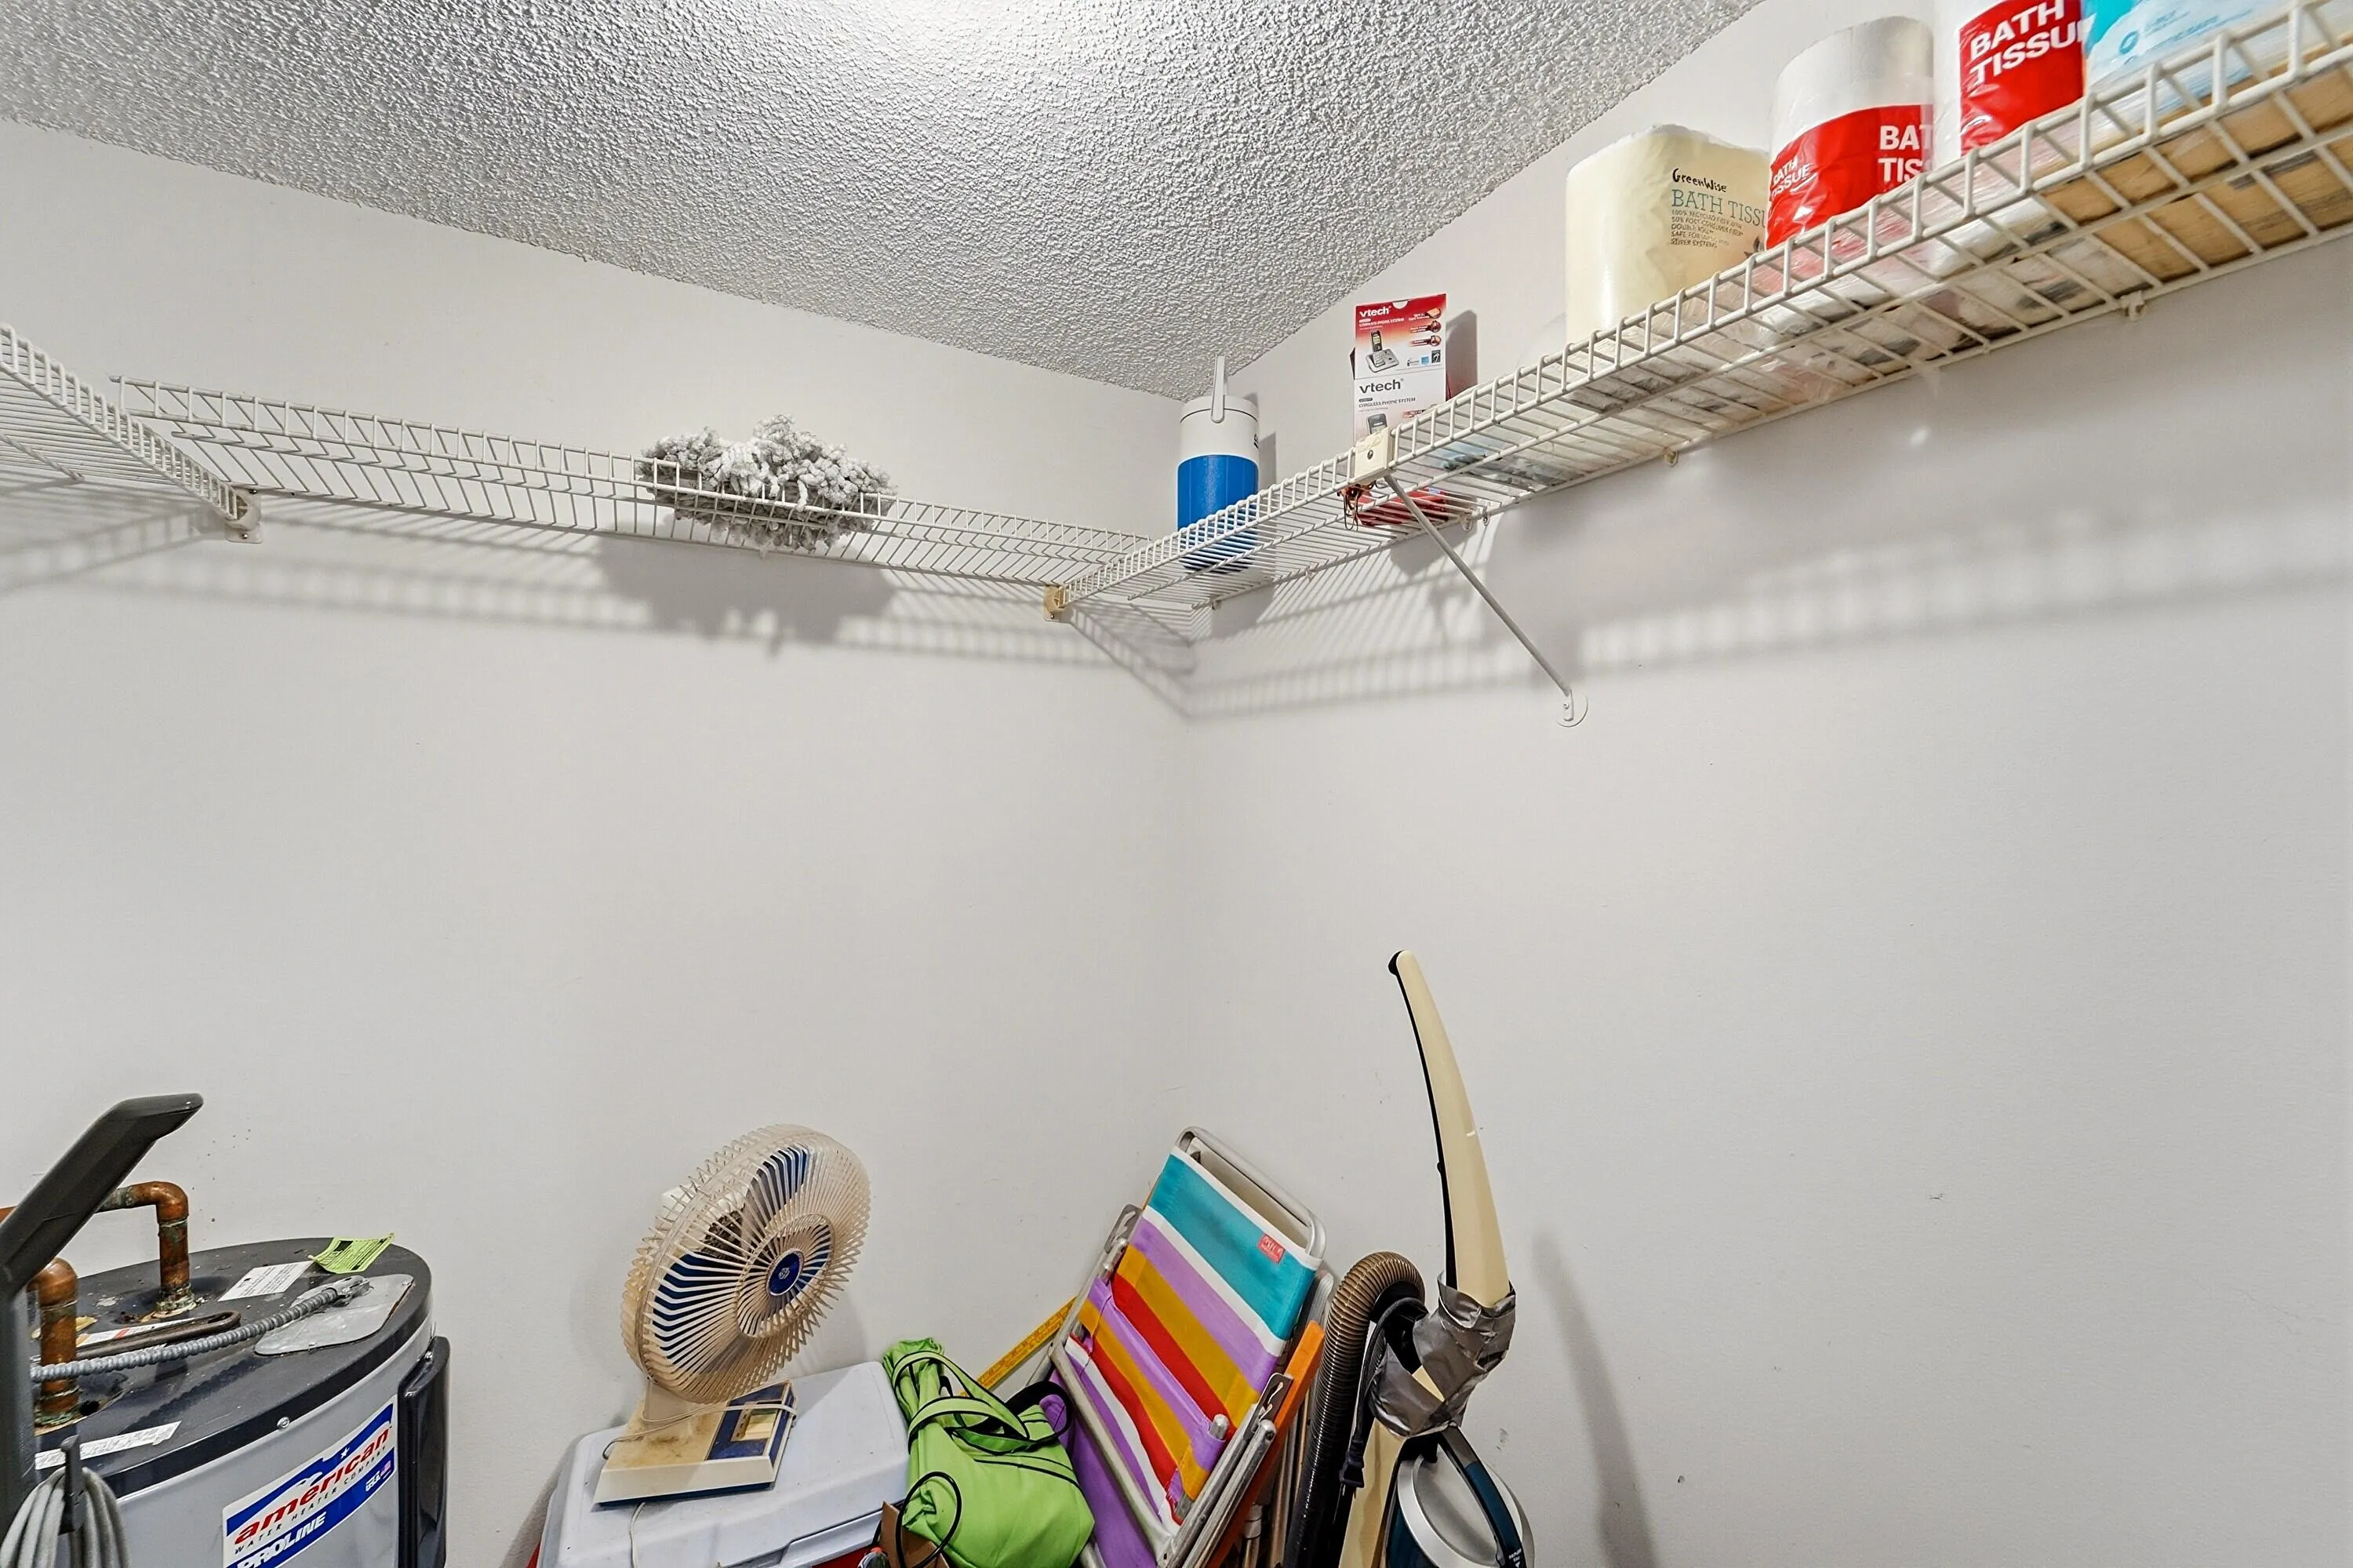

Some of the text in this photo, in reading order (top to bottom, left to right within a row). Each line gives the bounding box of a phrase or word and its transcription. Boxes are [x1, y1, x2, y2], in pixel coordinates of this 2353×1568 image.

[1970, 0, 2064, 61] BATH
[1672, 168, 1727, 192] GreenWise
[1671, 189, 1723, 215] BATH
[1359, 306, 1390, 318] vtech
[1359, 380, 1401, 394] vtech
[235, 1429, 389, 1544] american
[235, 1523, 282, 1555] WATER
[292, 1487, 336, 1521] HEATER
[237, 1512, 328, 1568] PROLINE
